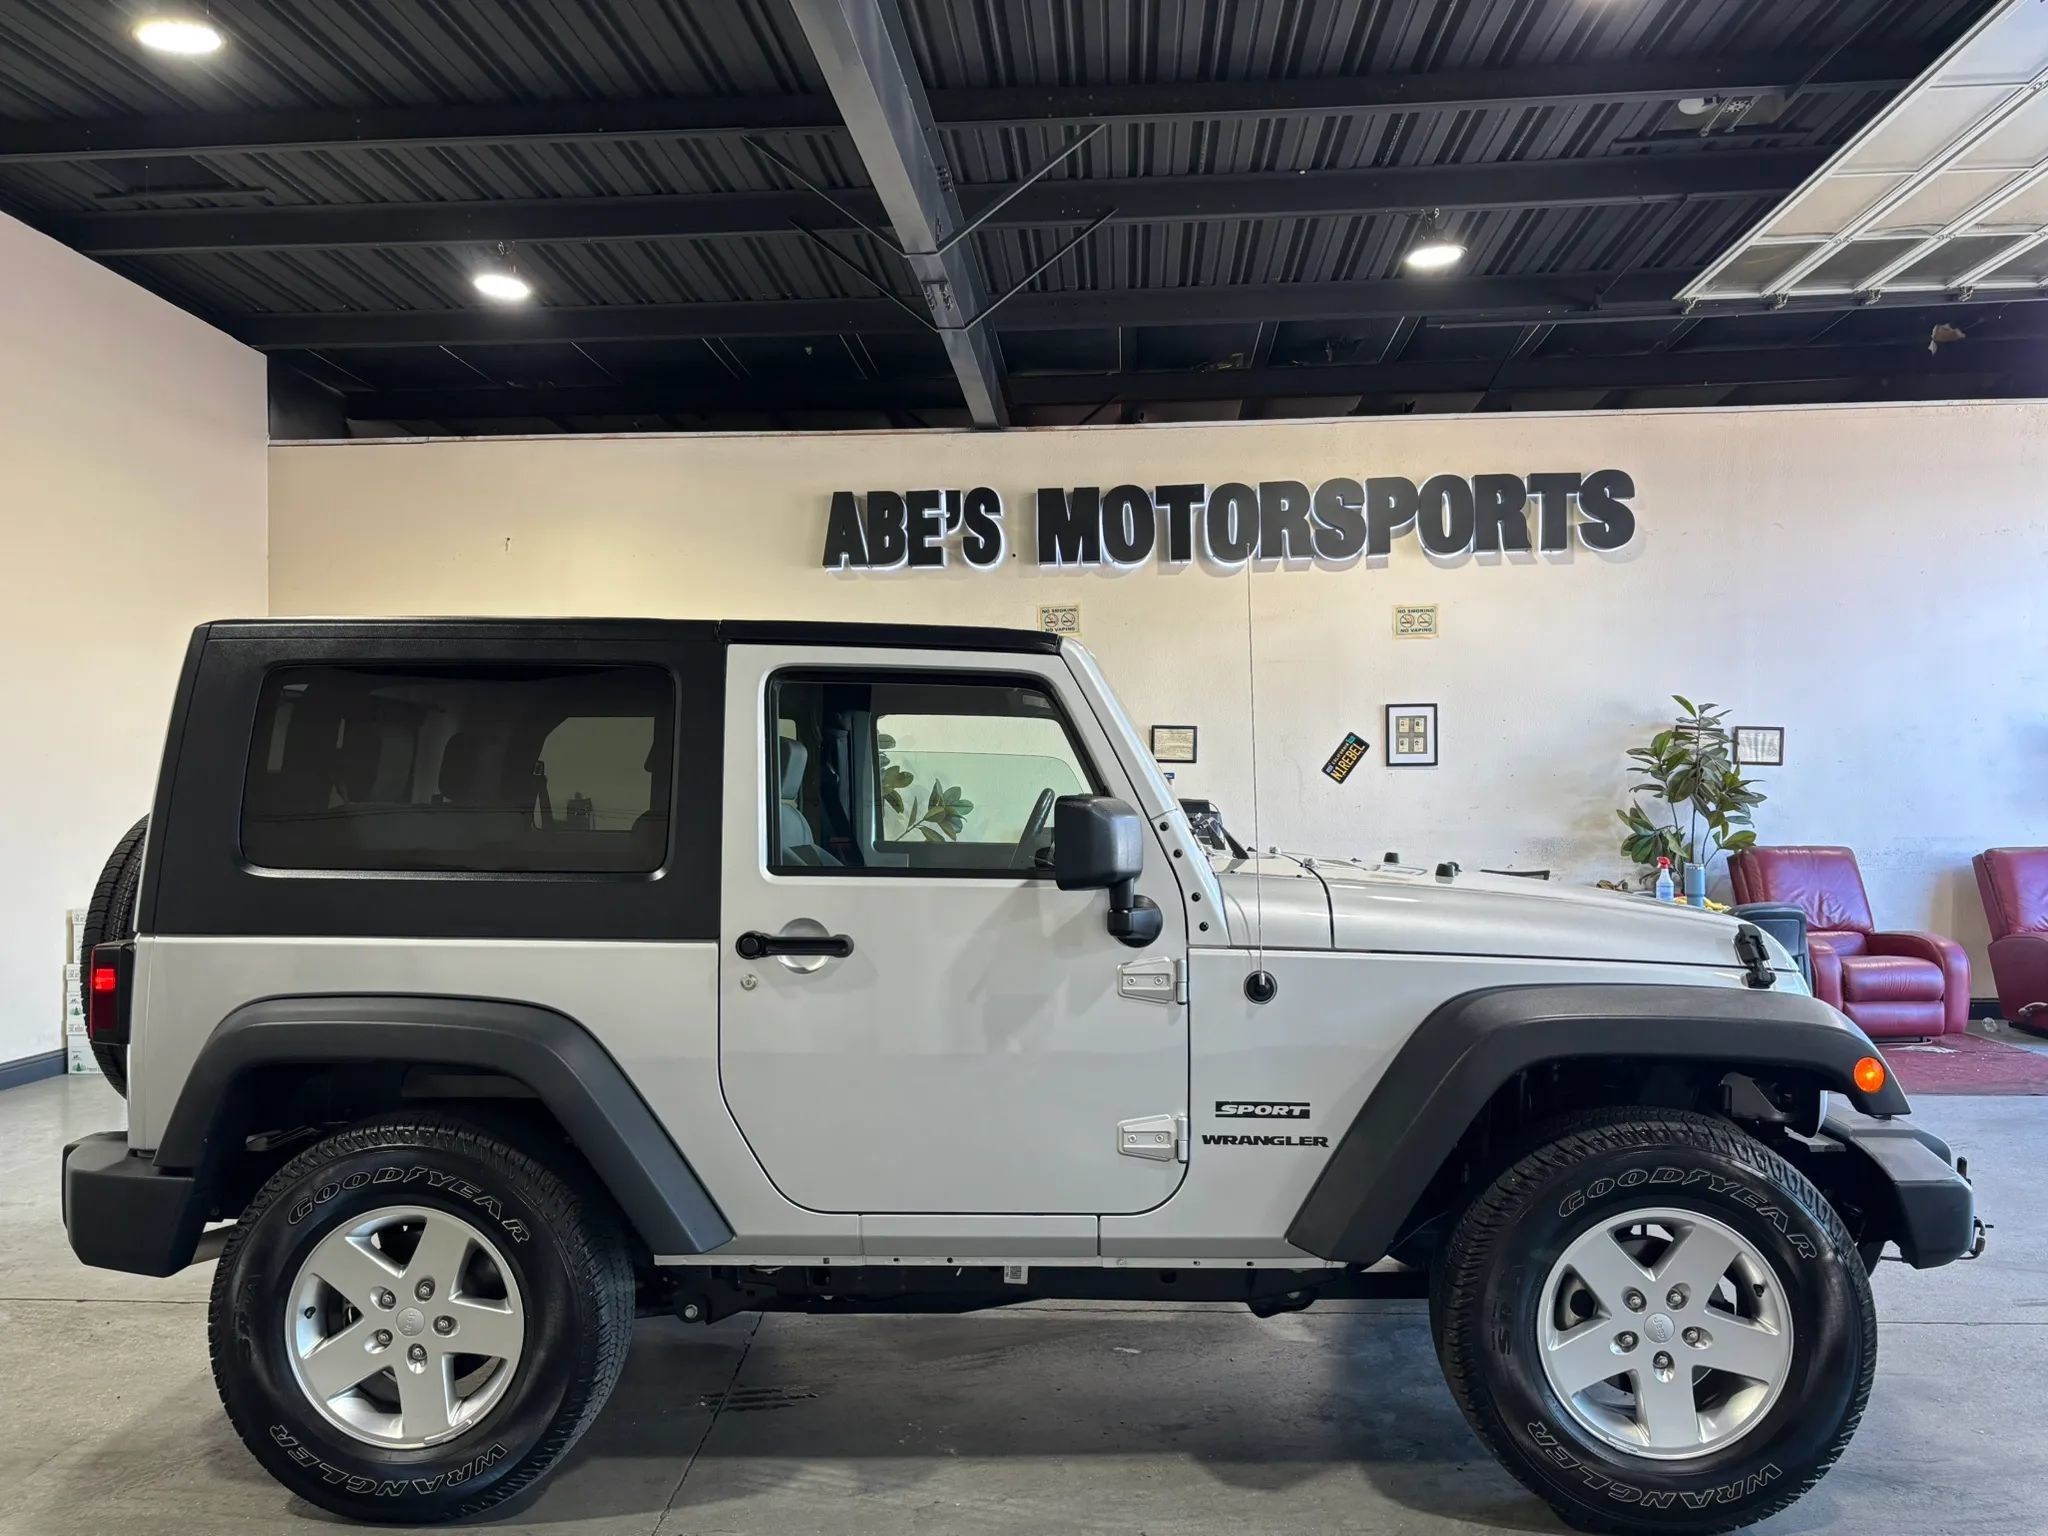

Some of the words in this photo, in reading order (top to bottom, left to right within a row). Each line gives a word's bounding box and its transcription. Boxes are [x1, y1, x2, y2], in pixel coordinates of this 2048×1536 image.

[822, 486, 1002, 569] ABE'S
[1036, 469, 1636, 569] MOTORSPORTS
[1201, 1134, 1329, 1148] WRANGLER
[1215, 1103, 1310, 1117] SPORT
[287, 1165, 530, 1243] GOODYEAR
[1558, 1167, 1818, 1259] GOODYEAR
[269, 1424, 511, 1497] WRANGLER
[1527, 1421, 1784, 1510] WRANGLER
